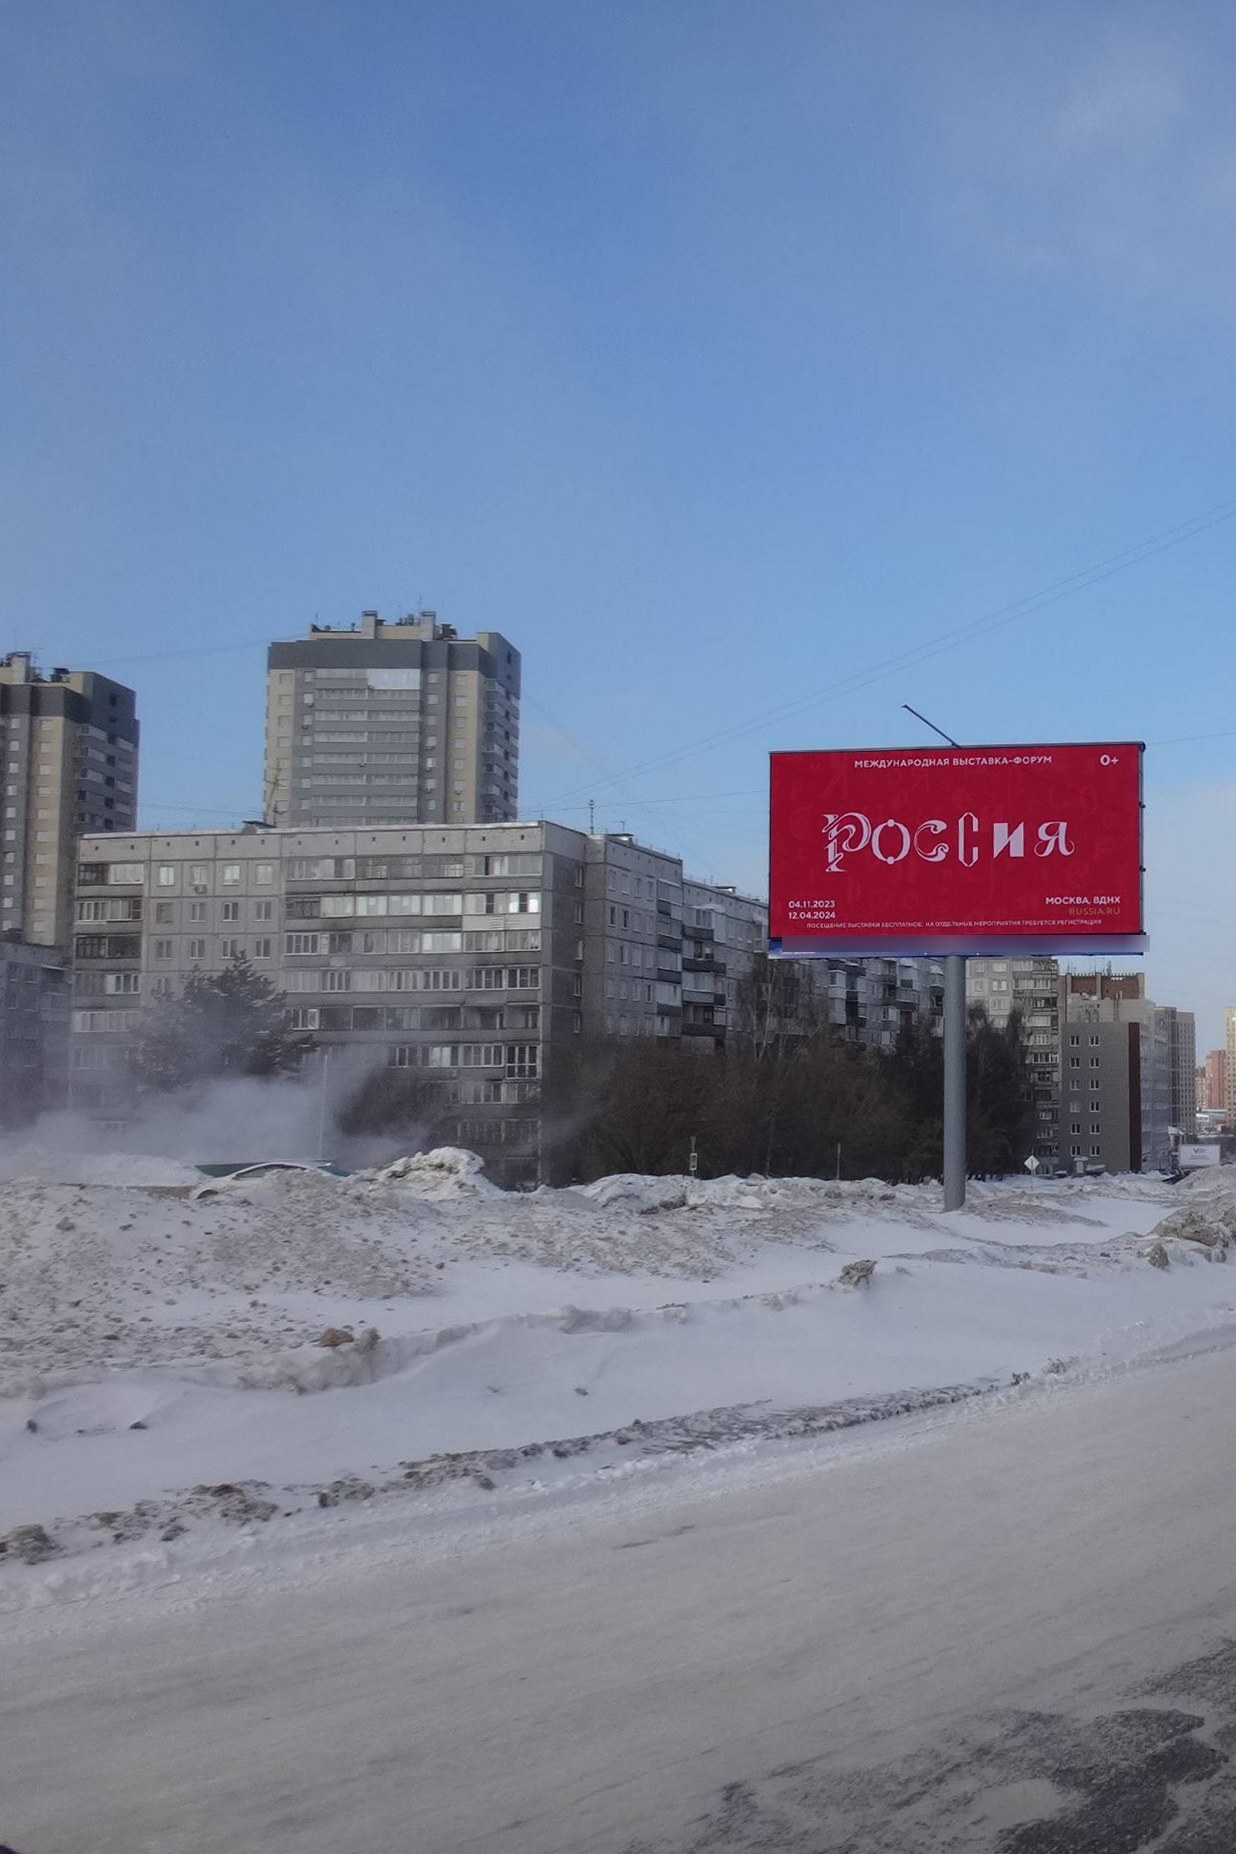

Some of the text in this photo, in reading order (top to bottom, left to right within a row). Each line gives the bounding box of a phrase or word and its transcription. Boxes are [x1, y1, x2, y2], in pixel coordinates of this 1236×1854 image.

[854, 756, 1052, 769] МЕЖДУНАРОДНАЯ ВЫСТАВКА-ФОРУМ
[788, 900, 836, 909] 04.11.2023
[1093, 896, 1121, 904] ВДНХ
[788, 911, 836, 920] 12.04.2024
